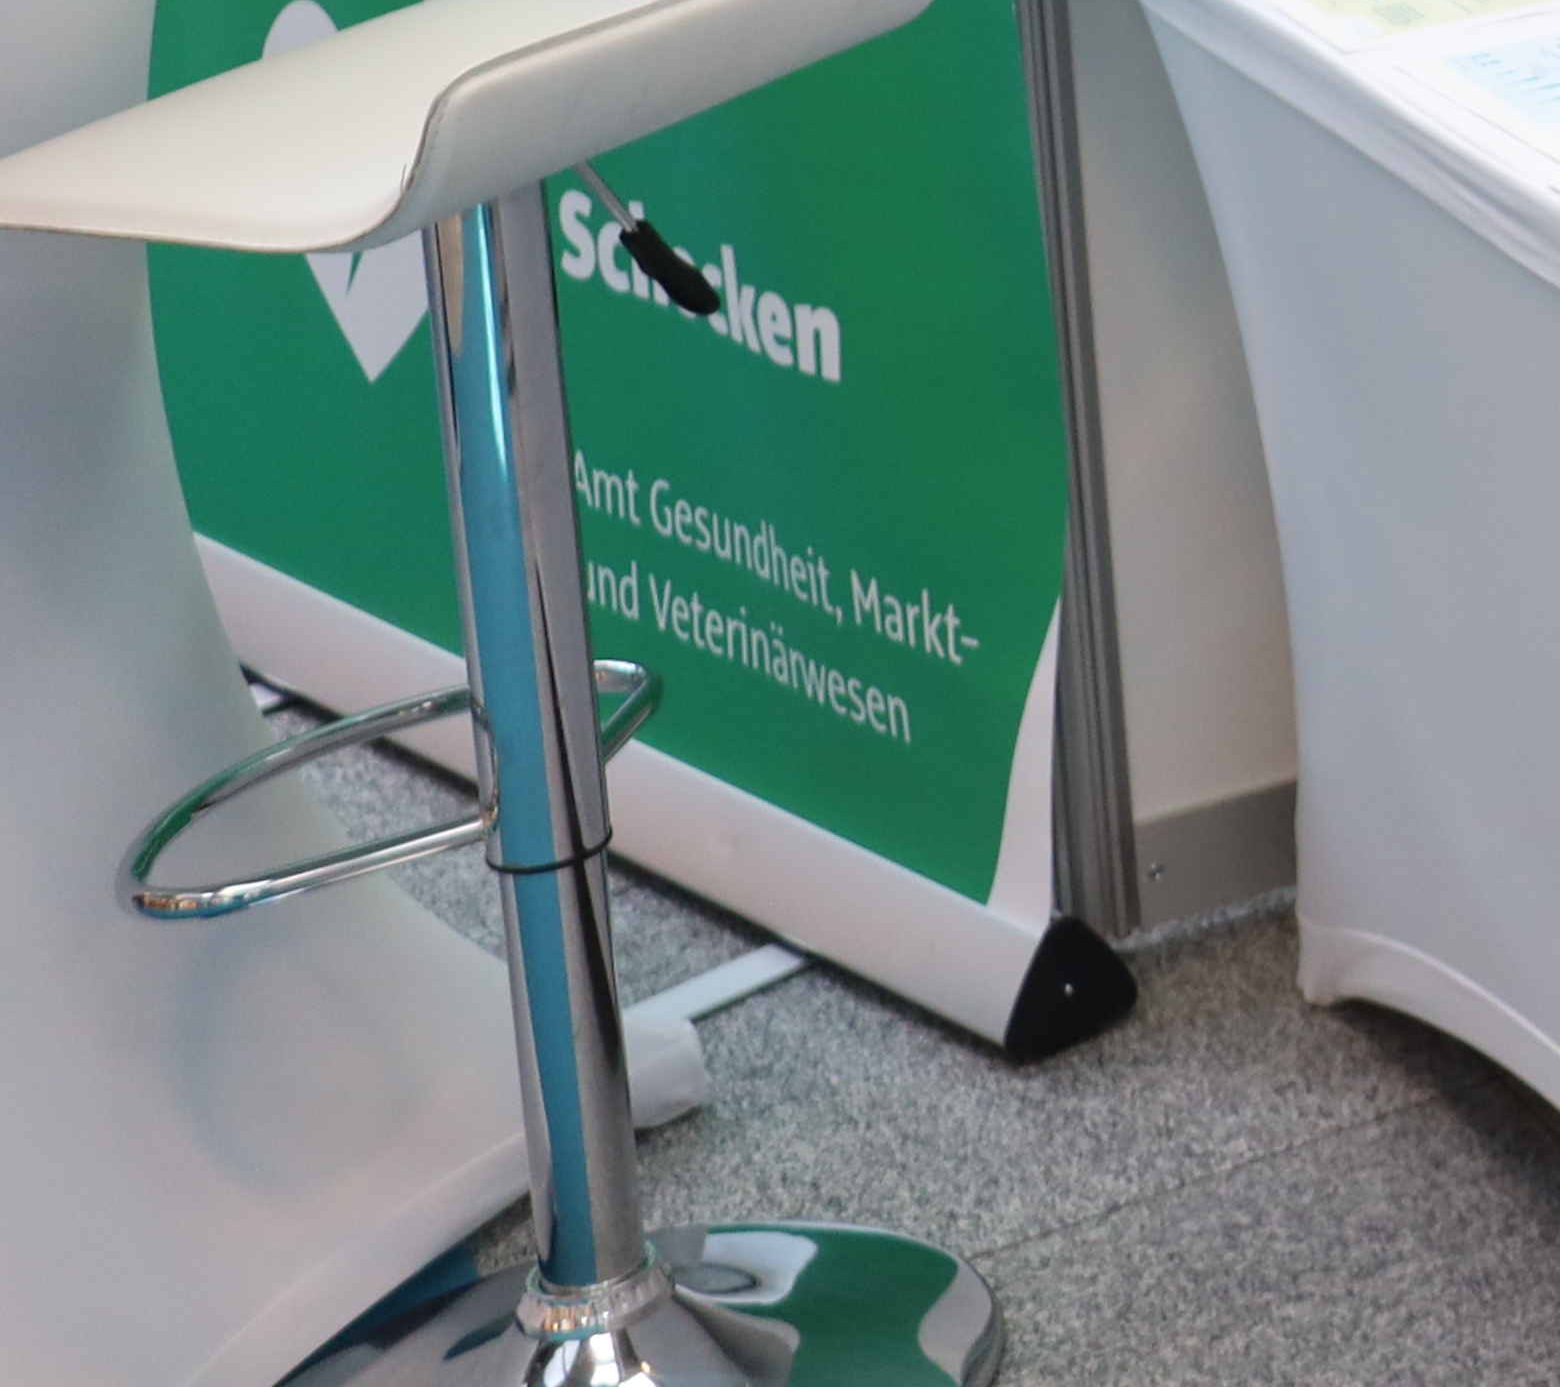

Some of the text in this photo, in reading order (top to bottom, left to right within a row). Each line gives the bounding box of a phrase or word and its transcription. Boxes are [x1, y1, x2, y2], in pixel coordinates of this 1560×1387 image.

[558, 189, 841, 383] Sccken
[574, 448, 980, 665] Amt Gesundheit, Markt-
[648, 572, 912, 744] Veterinärwesen
